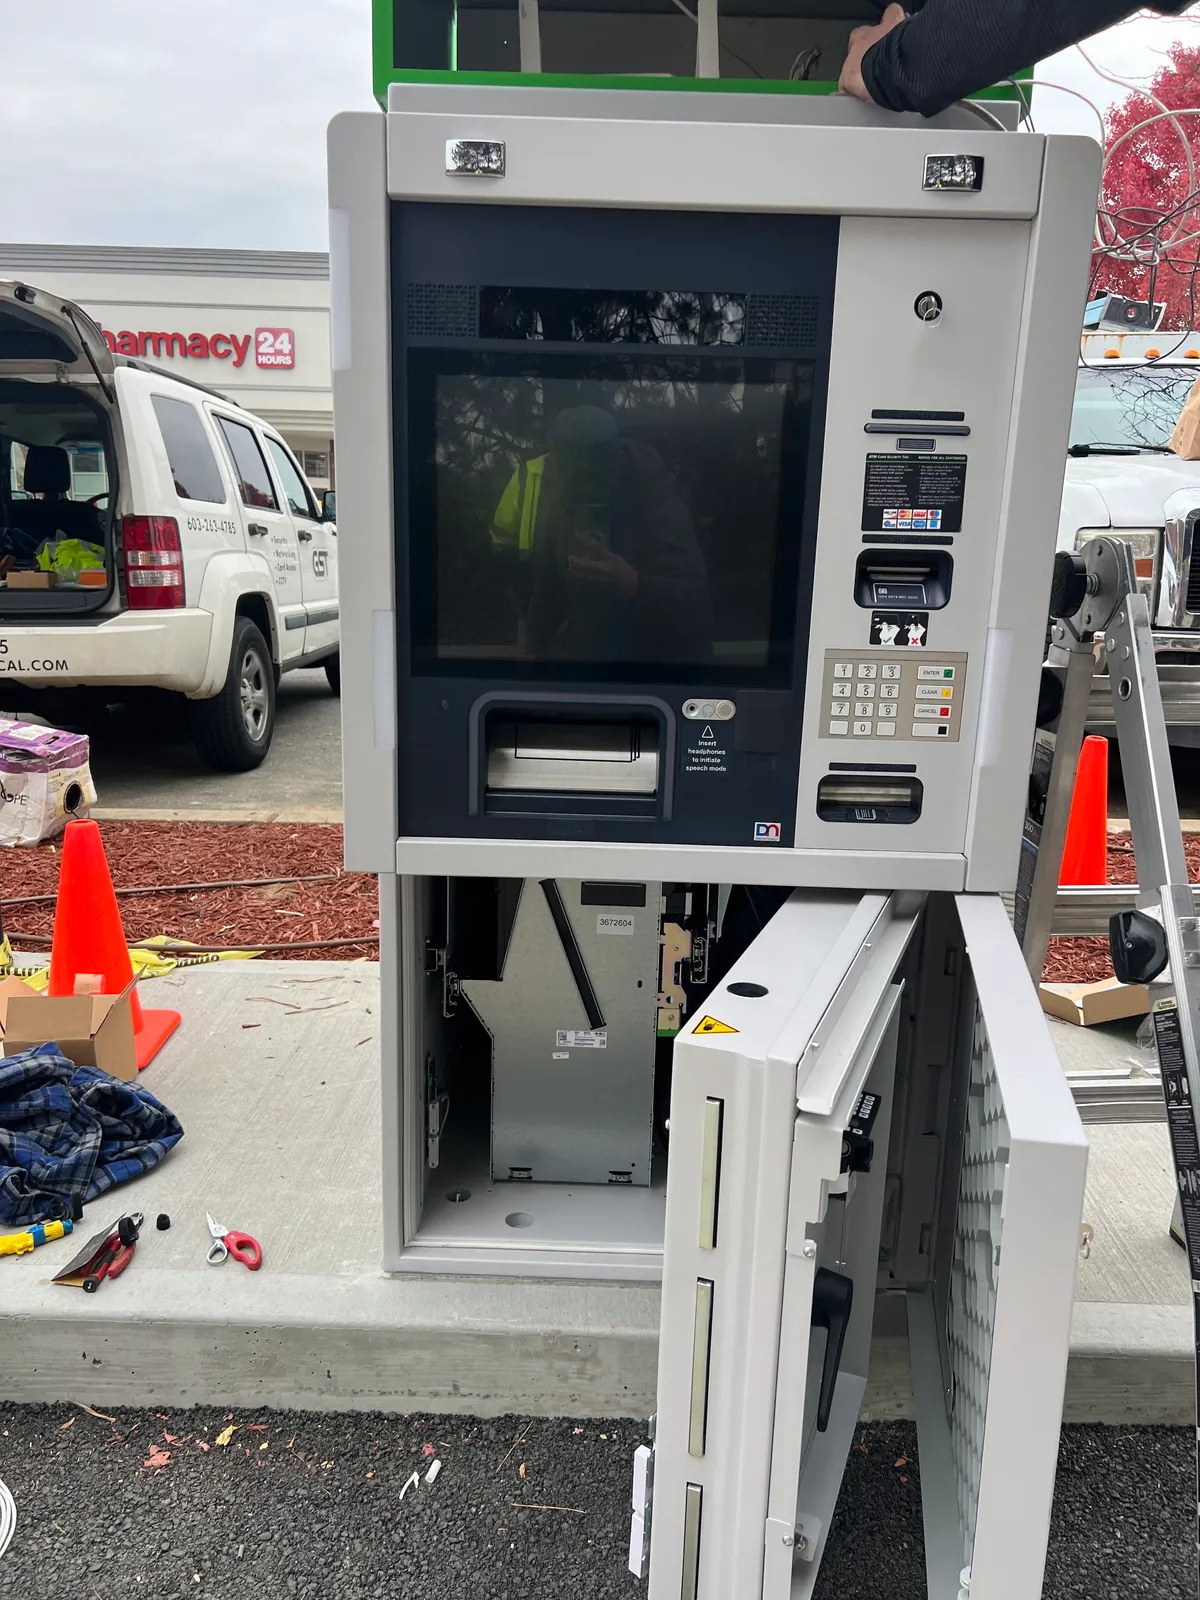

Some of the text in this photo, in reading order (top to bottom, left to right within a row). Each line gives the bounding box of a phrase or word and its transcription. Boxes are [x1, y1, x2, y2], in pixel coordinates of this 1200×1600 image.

[94, 321, 251, 368] harmacy
[257, 331, 292, 354] 24
[257, 355, 292, 365] HOURS
[187, 517, 236, 535] 603-263-4785
[864, 669, 871, 677] 2
[888, 670, 895, 678] 3
[863, 688, 869, 696] 5
[887, 689, 893, 697] 6
[838, 706, 844, 714] 7
[861, 707, 867, 715] 8
[885, 707, 891, 715] 9
[860, 724, 866, 732] 0
[687, 748, 726, 756] headphones
[685, 765, 708, 773] speech
[599, 918, 632, 927] 3672604
